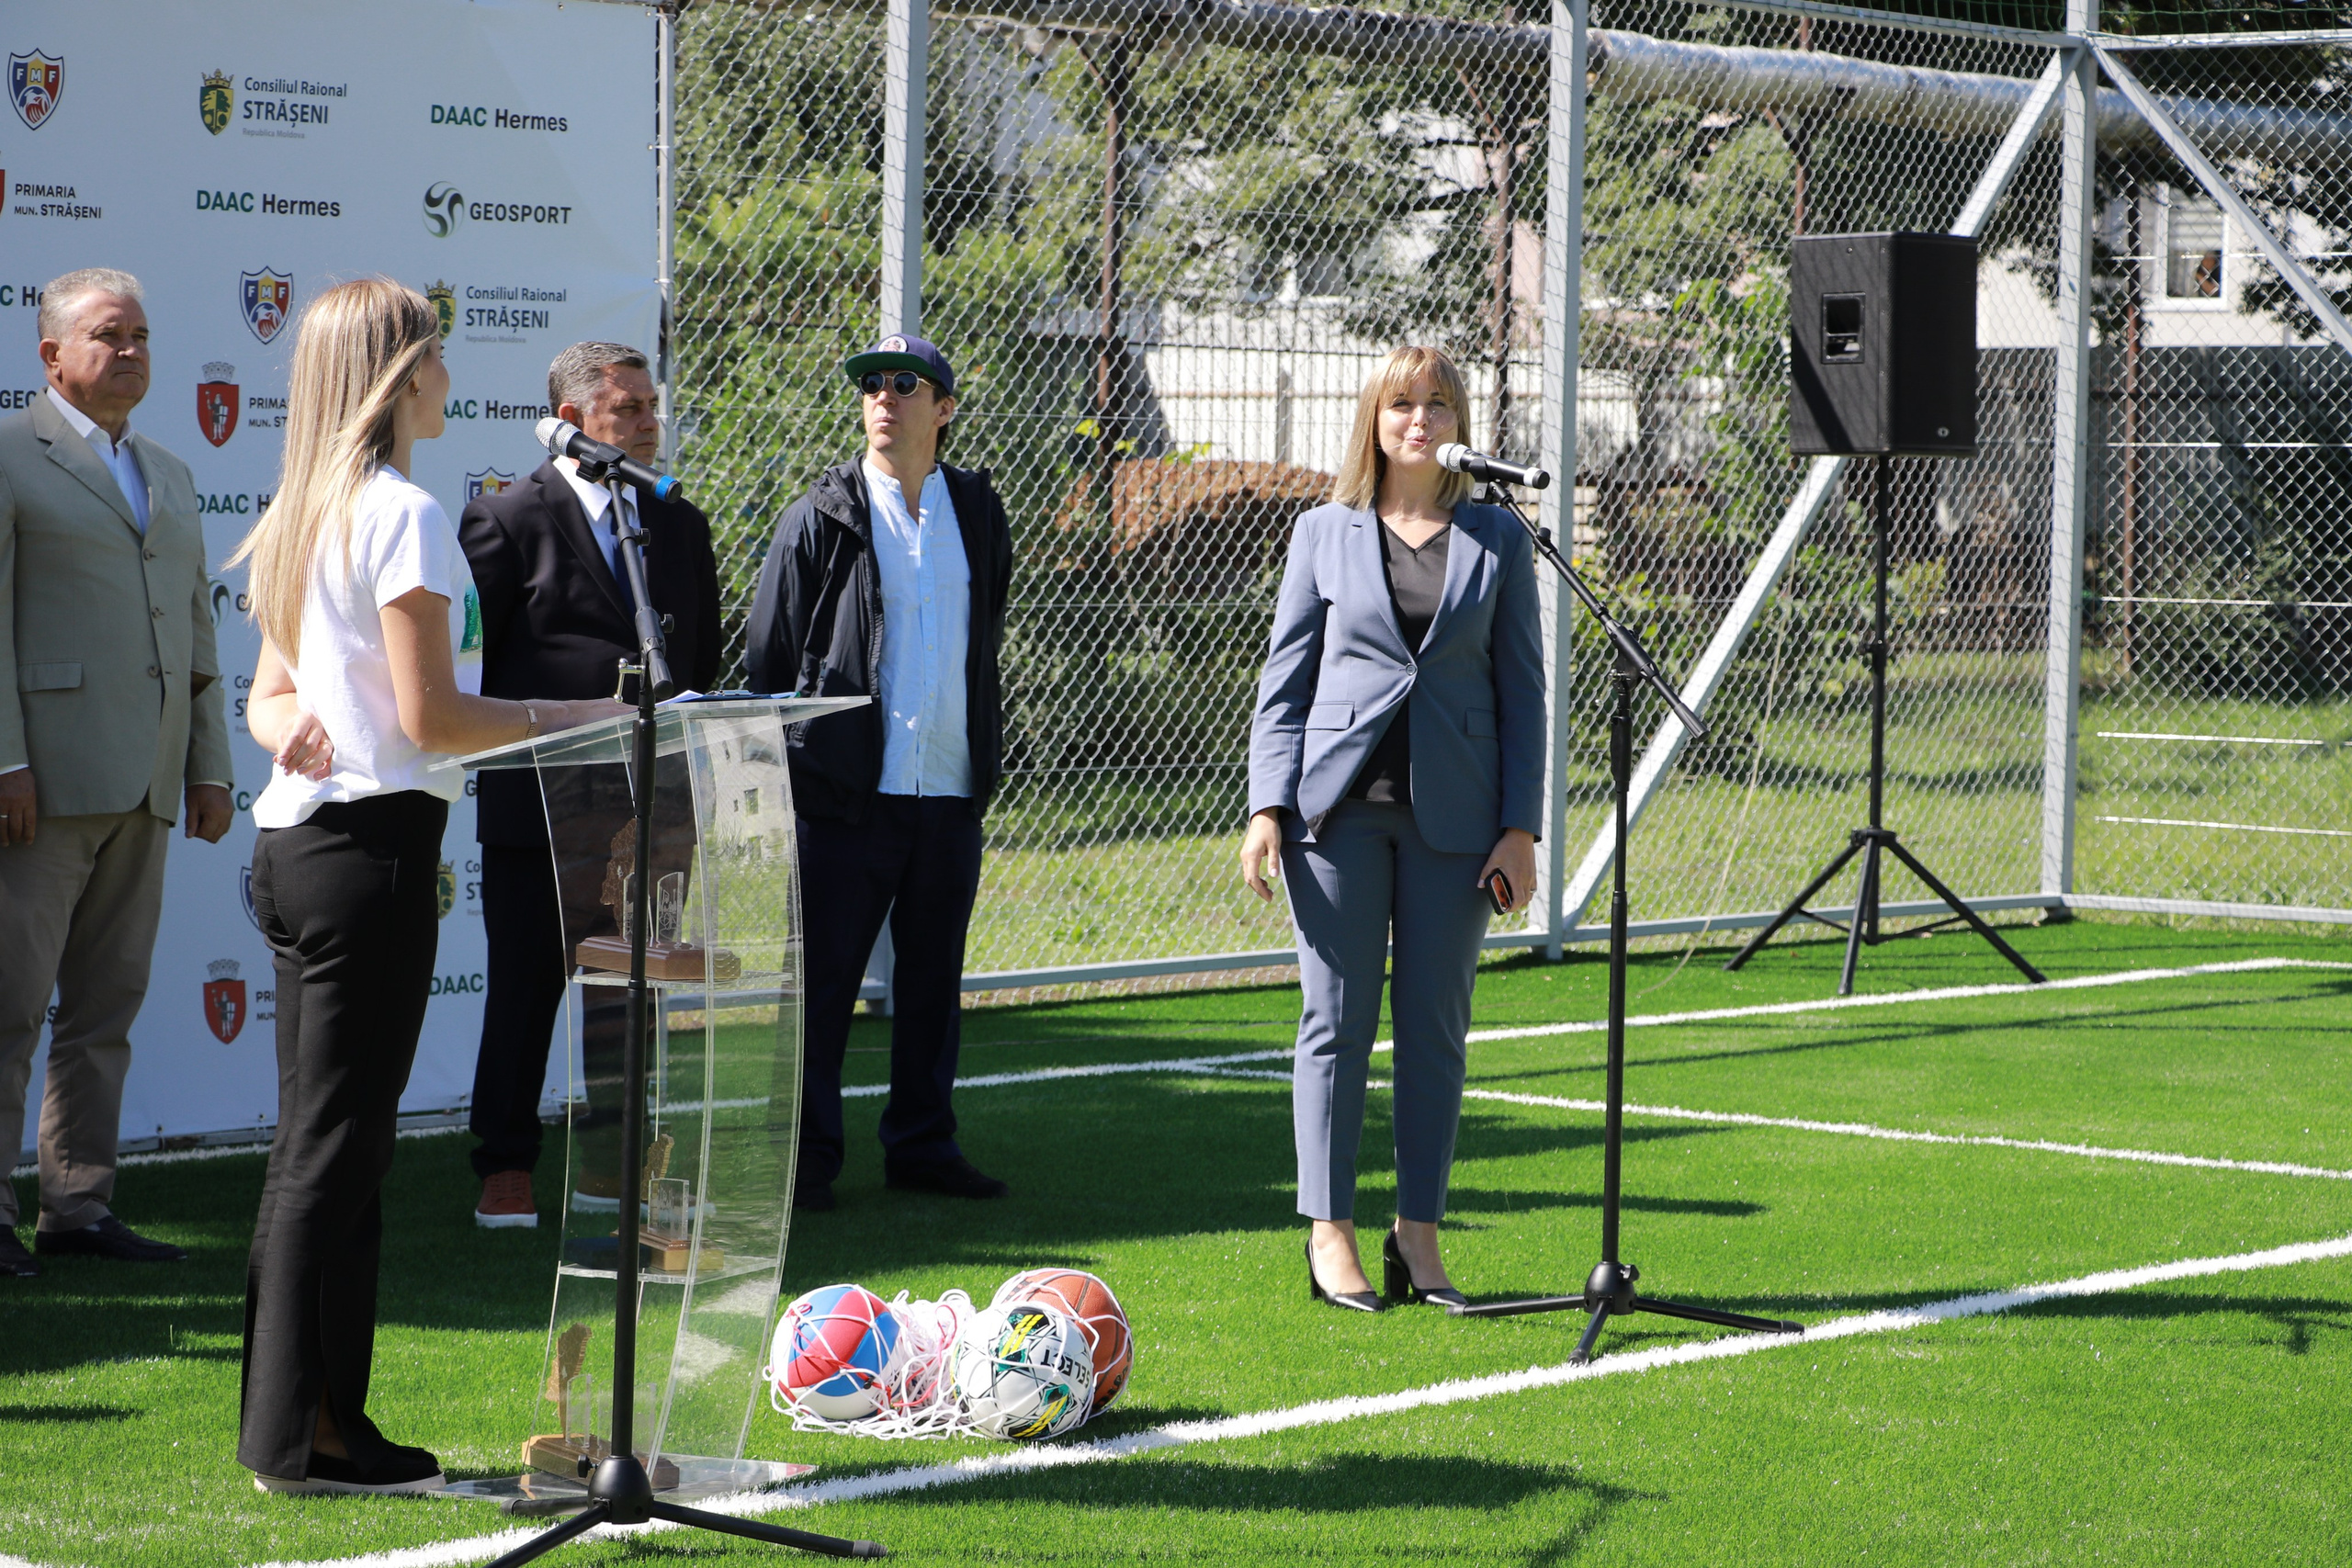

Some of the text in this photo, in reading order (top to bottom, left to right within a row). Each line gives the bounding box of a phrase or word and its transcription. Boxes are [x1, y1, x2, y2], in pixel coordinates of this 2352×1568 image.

[17, 68, 56, 83] FMF
[244, 77, 347, 97] Consiliul Raional
[243, 98, 329, 128] STRĂȘENI
[431, 104, 568, 132] DAAC Hermes
[242, 128, 305, 139] Republica Moldova
[15, 183, 76, 198] PRIMARIA
[14, 202, 102, 220] MUN. STRĂȘENI
[196, 189, 341, 217] DAAC Hermes
[469, 202, 571, 224] GEOSPORT
[248, 286, 286, 299] FMF
[466, 286, 567, 302] Consiliul Raional
[465, 306, 549, 333] STRĂȘENI
[465, 334, 526, 344] Republica Moldova
[249, 397, 289, 410] PRIMA
[485, 400, 549, 419] Herme
[248, 418, 271, 427] MUN.
[429, 973, 484, 996] DAAC
[1040, 1349, 1090, 1388] SELECT
